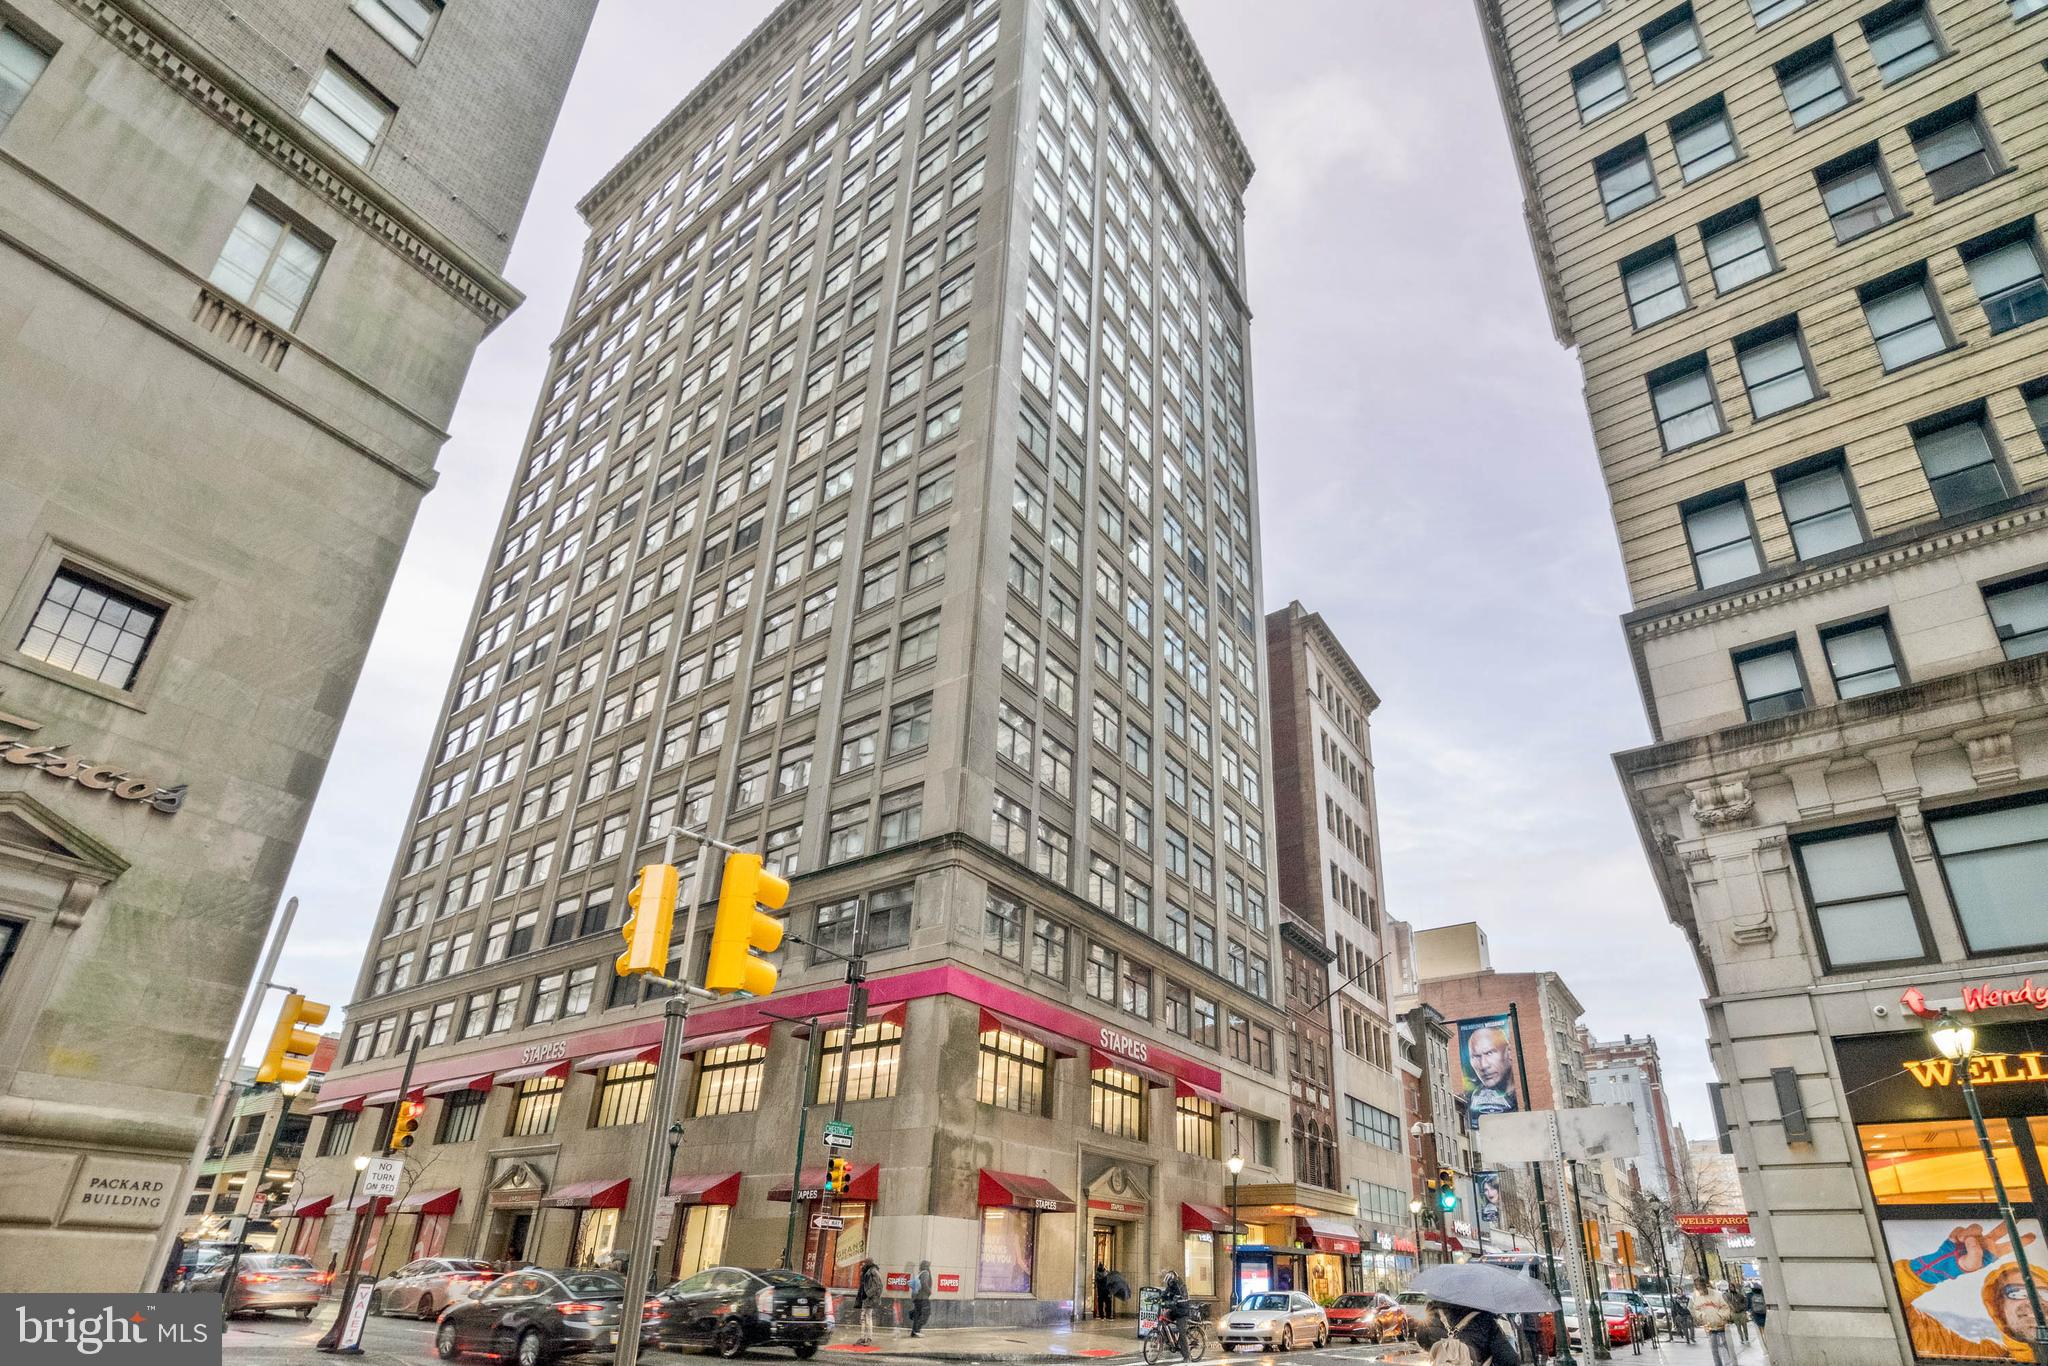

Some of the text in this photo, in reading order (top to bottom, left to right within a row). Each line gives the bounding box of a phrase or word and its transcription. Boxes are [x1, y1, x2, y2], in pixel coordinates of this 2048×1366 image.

[1100, 1028, 1148, 1062] STAPLES
[522, 1040, 567, 1064] STAPLES
[379, 1163, 393, 1171] NO
[372, 1173, 395, 1181] TURN
[90, 1178, 164, 1191] PACKARD
[366, 1182, 395, 1192] ON RED
[82, 1193, 161, 1207] BUILDING
[1035, 1200, 1057, 1210] STAPLES
[1680, 1217, 1714, 1225] WELLS
[836, 1240, 865, 1258] GRAND
[887, 1277, 907, 1286] STAPLES
[940, 1279, 959, 1287] STAPLES
[350, 1291, 369, 1338] VALET
